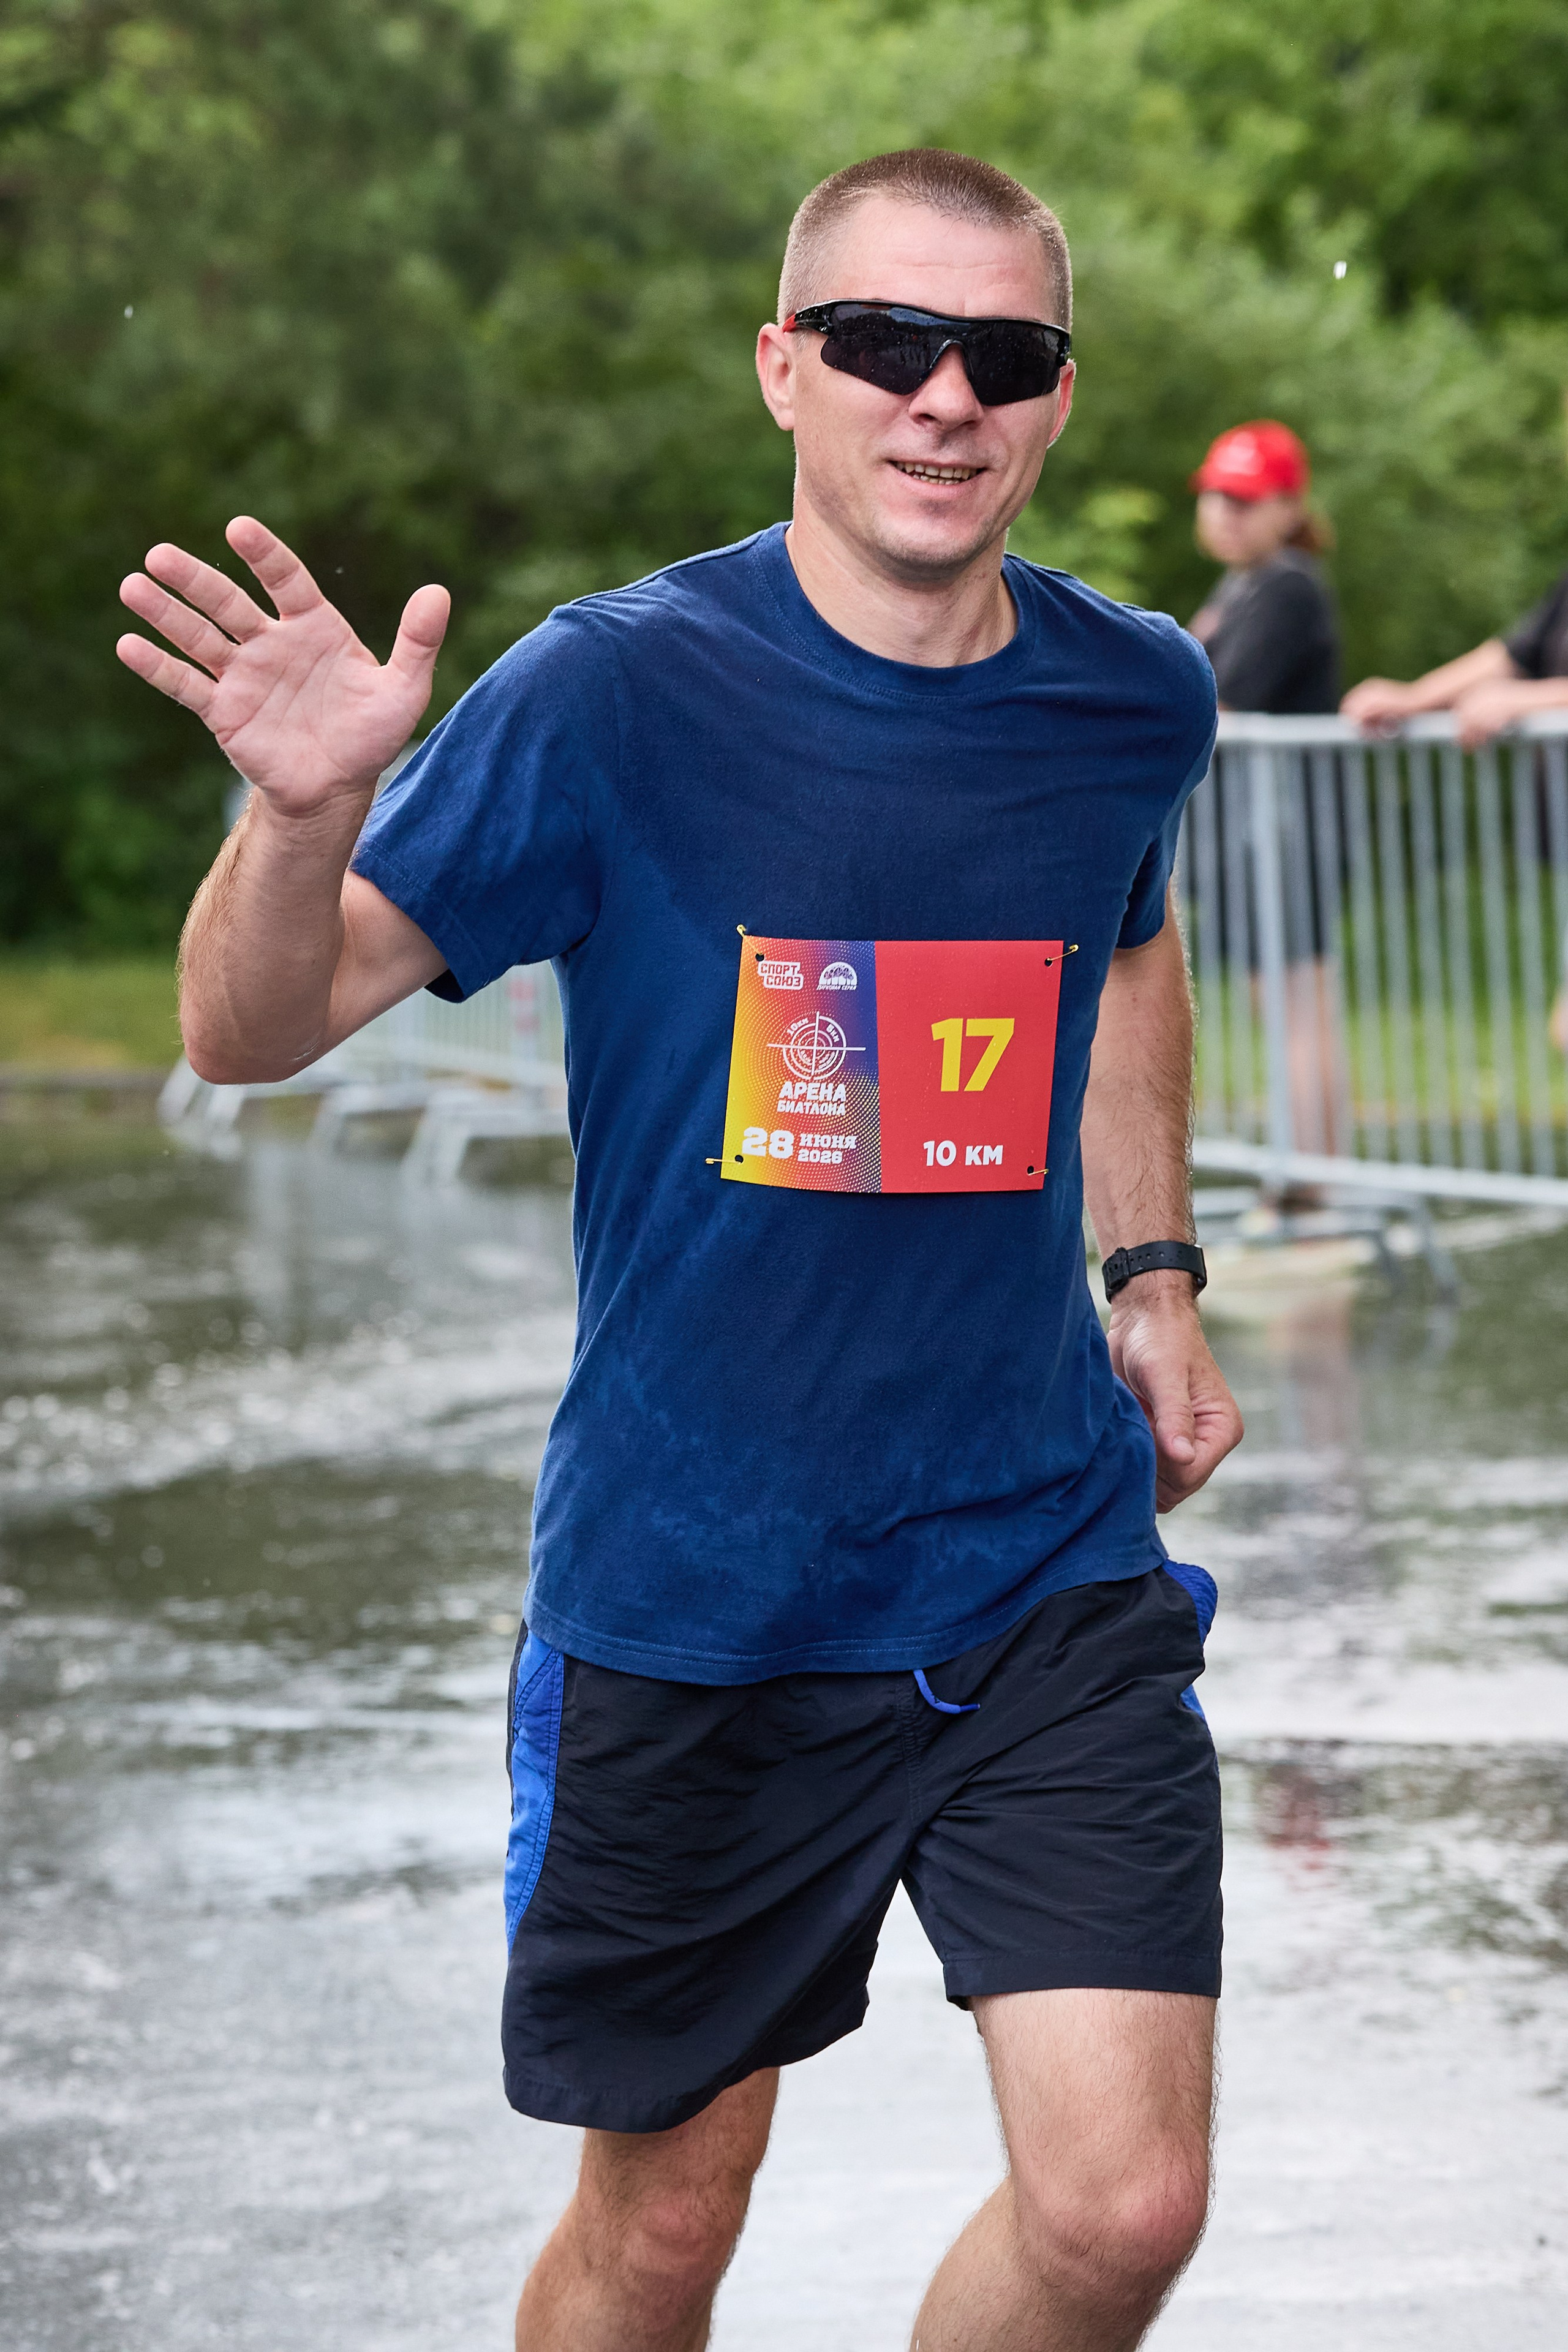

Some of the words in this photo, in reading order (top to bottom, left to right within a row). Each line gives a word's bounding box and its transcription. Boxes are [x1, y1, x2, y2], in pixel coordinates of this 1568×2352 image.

[761, 963, 797, 975] СПОРТ
[766, 976, 801, 987] СОЮЗ
[931, 1017, 1015, 1092] 17
[778, 1080, 846, 1102] АРЕНА
[777, 1099, 846, 1116] БИАТЛОНА
[742, 1126, 795, 1159] 28
[797, 1148, 843, 1164] 2026
[923, 1140, 957, 1167] 10
